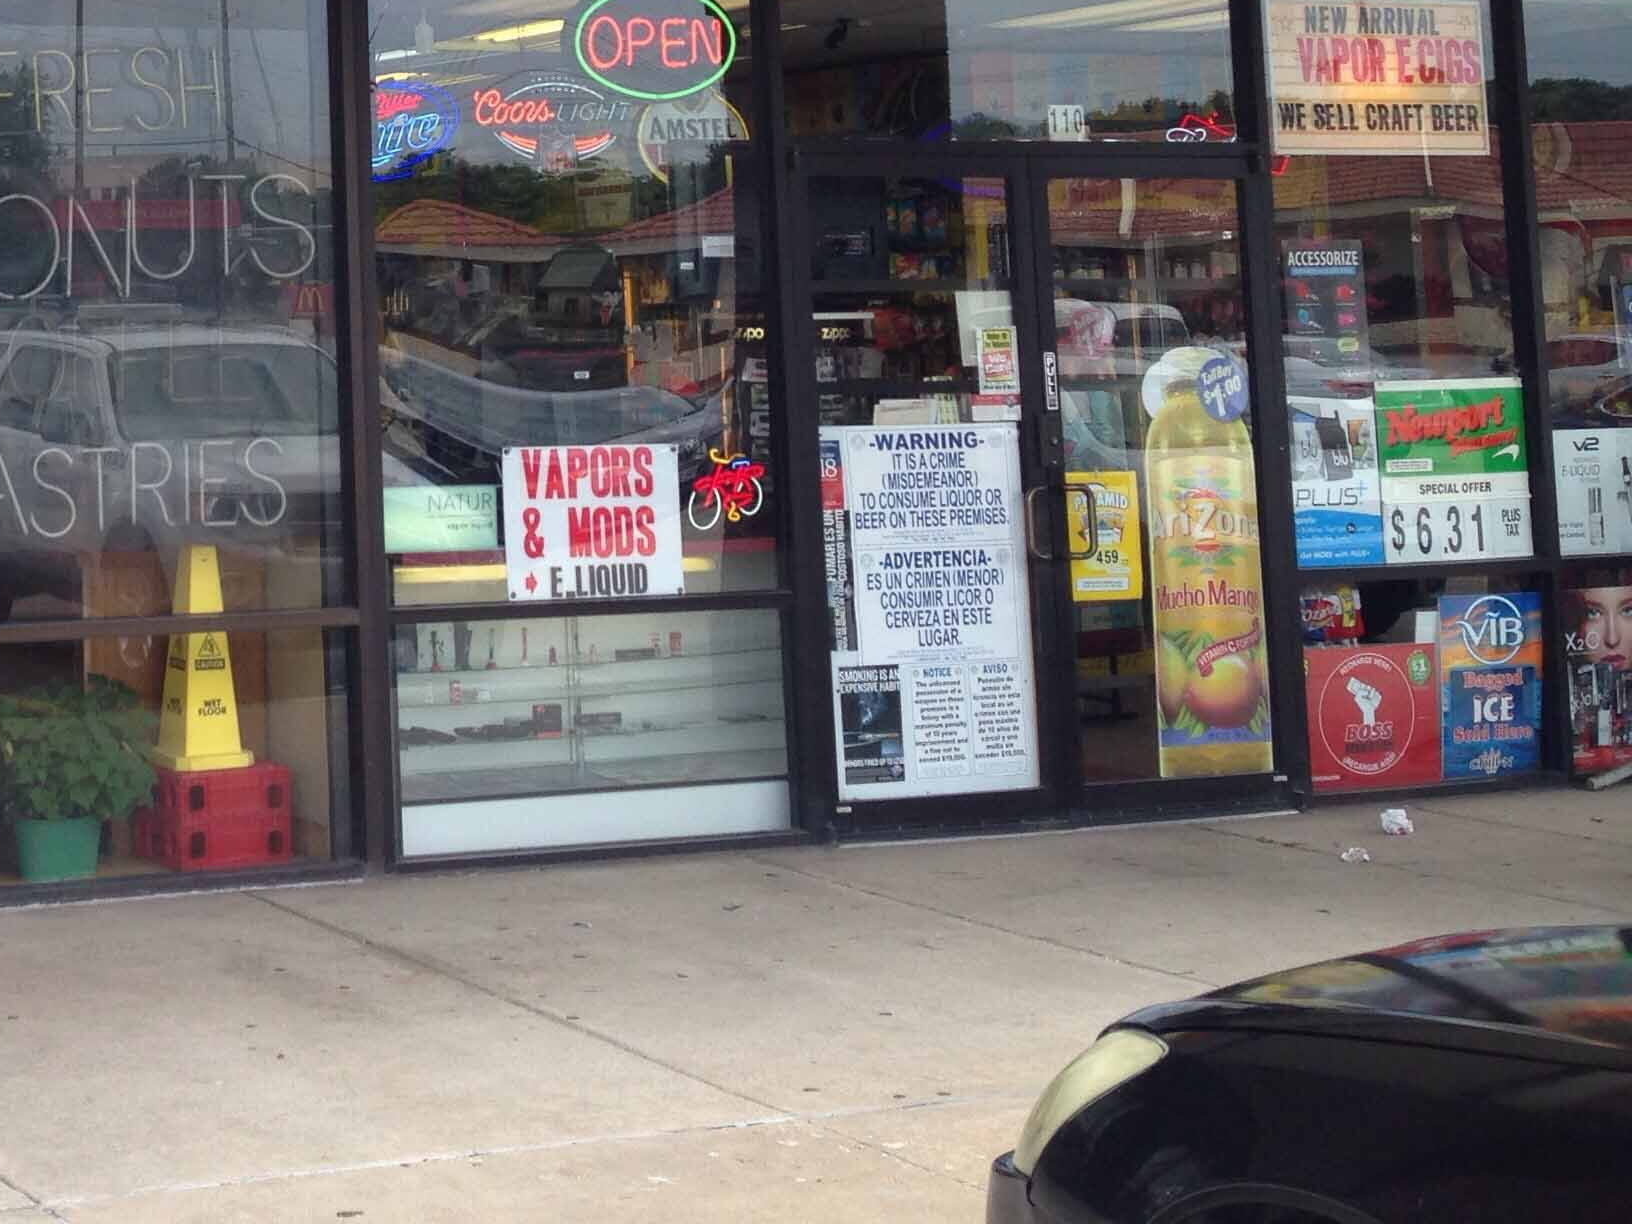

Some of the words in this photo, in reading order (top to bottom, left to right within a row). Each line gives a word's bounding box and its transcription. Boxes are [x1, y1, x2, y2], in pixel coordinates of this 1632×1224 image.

[1304, 6, 1348, 34] NEW
[1357, 7, 1441, 36] ARRIVAL
[586, 15, 724, 69] OPEN
[1297, 36, 1386, 84] VAPOR
[473, 88, 554, 126] Coors
[556, 101, 632, 123] LIGHT
[1278, 103, 1306, 132] WE
[1313, 103, 1360, 132] SELL
[1367, 104, 1424, 132] CRAFT
[1431, 104, 1480, 132] BEER
[649, 117, 737, 141] AMSTEL
[1049, 109, 1084, 134] 110
[1287, 250, 1361, 267] ACCESSORIZE
[1046, 357, 1056, 396] PULL
[1385, 395, 1504, 448] Newport
[892, 453, 904, 470] IT
[905, 452, 917, 470] IS
[919, 452, 929, 469] A
[930, 451, 966, 469] CRIME
[1332, 448, 1350, 467] blu
[520, 446, 654, 500] VAPORS
[860, 493, 877, 510] TO
[879, 490, 937, 510] CONSUME
[939, 489, 983, 509] LIQUOR
[985, 488, 1003, 505] OR
[1419, 483, 1459, 496] SPECIAL
[1461, 482, 1492, 495] OFFER
[855, 511, 887, 530] BEER
[889, 510, 907, 528] ON
[910, 509, 947, 528] THESE
[949, 507, 1010, 526] PREMISES.
[1501, 508, 1522, 523] PLUS
[522, 507, 546, 560] &
[567, 505, 657, 560] MODS
[1504, 523, 1521, 538] TAX
[825, 543, 838, 583] FUMAR
[867, 573, 882, 591] ES
[885, 572, 902, 589] UN
[905, 570, 951, 588] CRIMEN
[880, 591, 944, 610] CONSUMIR
[946, 589, 984, 607] LICOR
[985, 588, 994, 605] O
[1156, 582, 1205, 611] Mucho
[1207, 579, 1259, 614] Mang
[885, 610, 941, 629] CERVEZA
[943, 609, 960, 627] EN
[962, 607, 993, 626] ESTE
[839, 670, 879, 683] SMOKING
[879, 669, 888, 681] IS
[923, 667, 952, 678] NOTICE
[982, 663, 1008, 674] AVISO
[840, 683, 880, 694] EXPENSIVE
[1462, 668, 1524, 692] Bagged
[1472, 693, 1515, 723] ICE
[1344, 723, 1393, 743] BOSS
[1453, 725, 1489, 743] Sold
